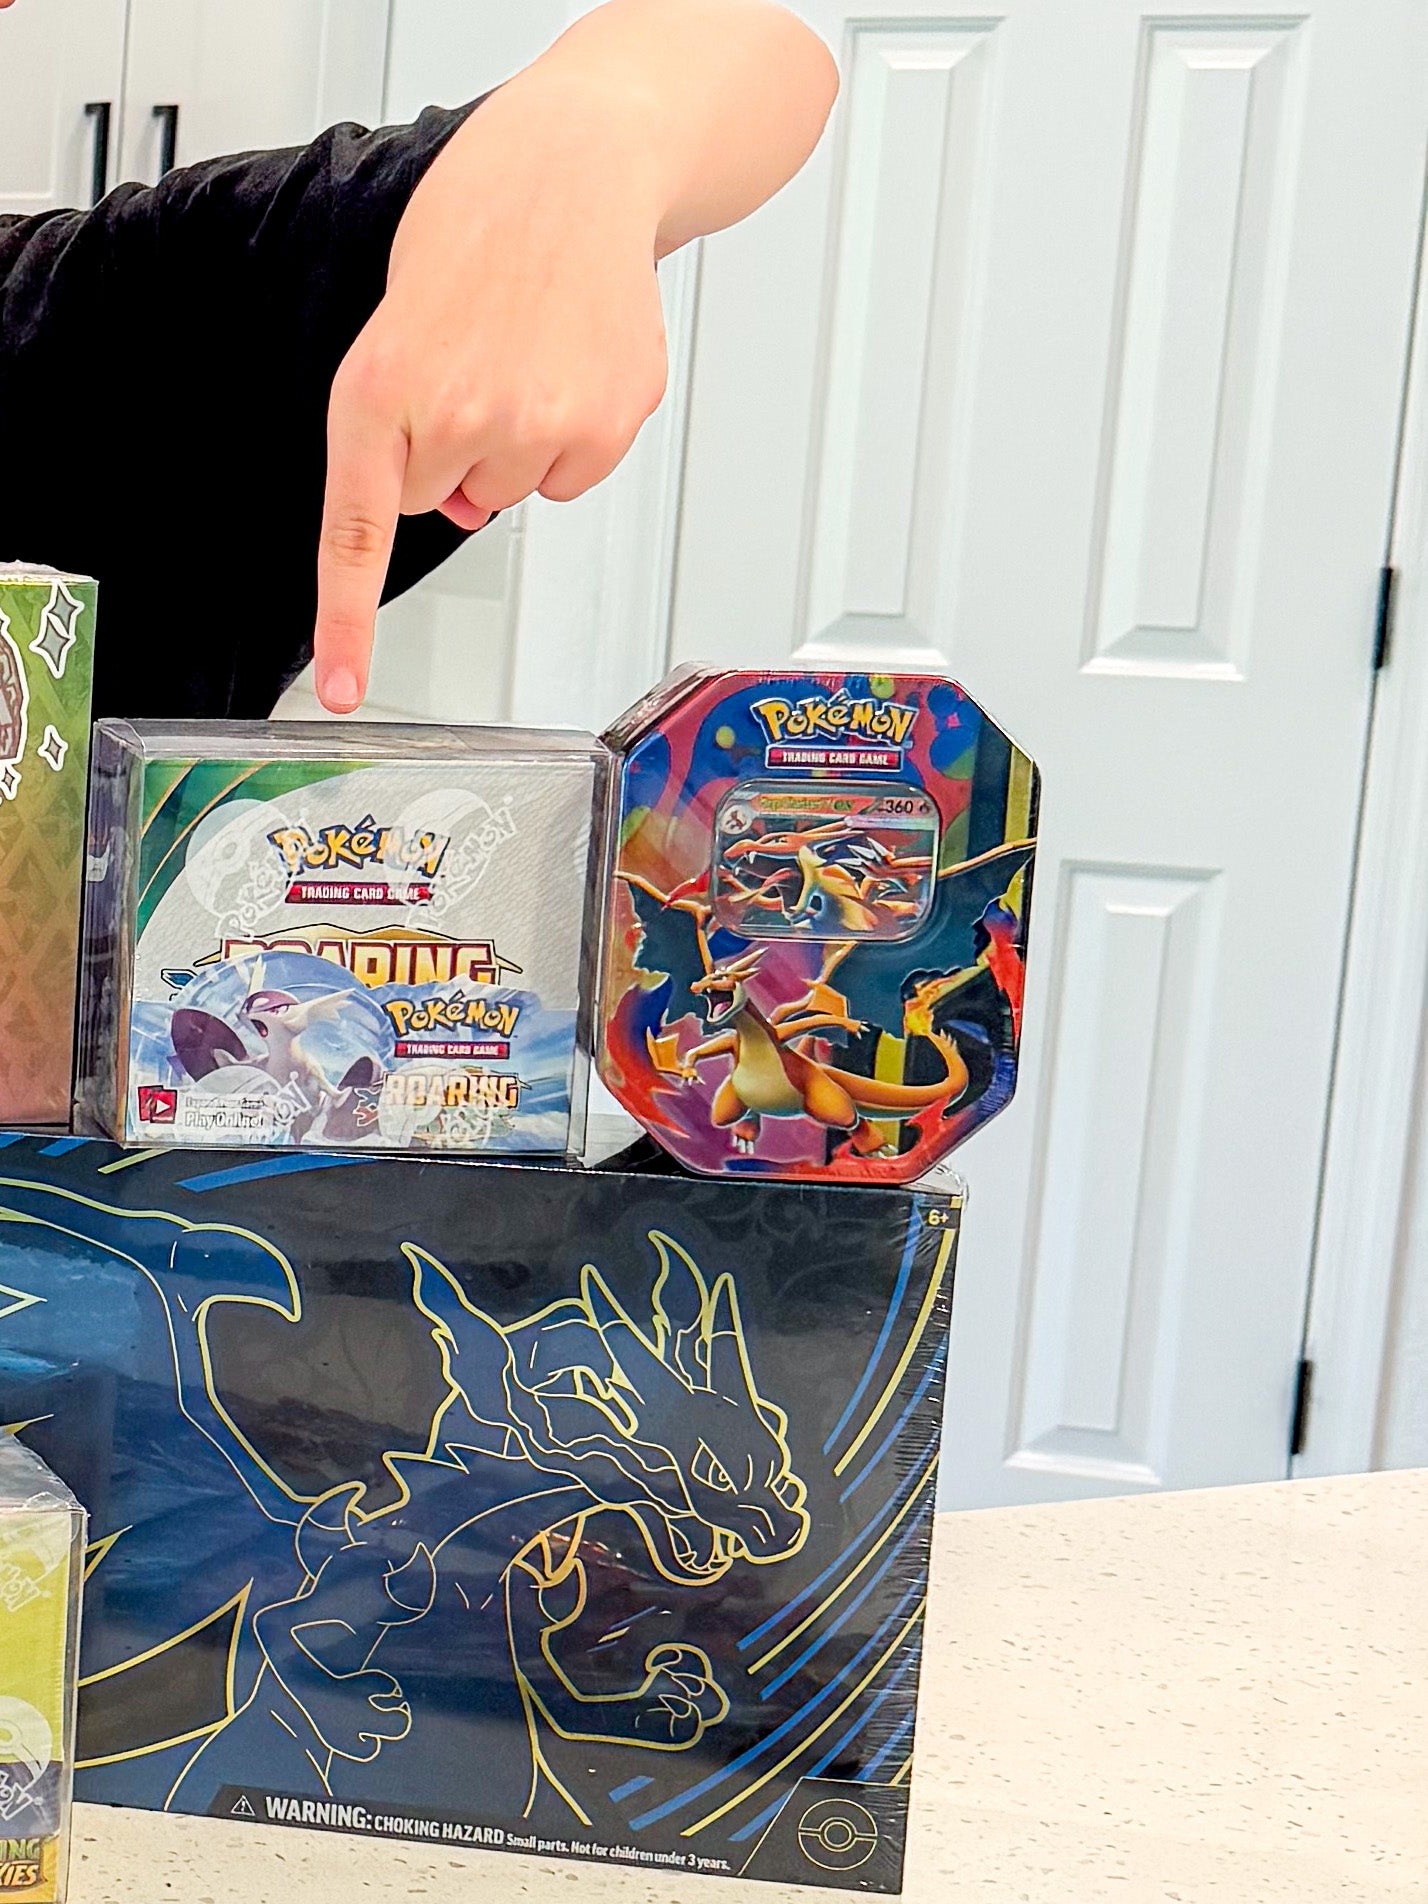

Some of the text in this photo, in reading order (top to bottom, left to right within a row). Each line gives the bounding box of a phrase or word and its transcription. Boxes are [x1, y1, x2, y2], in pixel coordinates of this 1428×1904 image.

[782, 751, 889, 765] TRADING CARD GAME
[885, 799, 914, 814] 360
[301, 886, 384, 901] TRADING CARD
[406, 1044, 499, 1056] TRADING CARD GAME
[266, 1797, 373, 1830] WARNING:
[375, 1815, 440, 1838] CHOKING
[442, 1823, 505, 1845] HAZARD
[506, 1833, 537, 1850] Small
[537, 1838, 569, 1854] parts.
[571, 1840, 590, 1855] Not
[609, 1845, 653, 1862] children
[654, 1849, 686, 1867] under
[696, 1856, 732, 1871] years.
